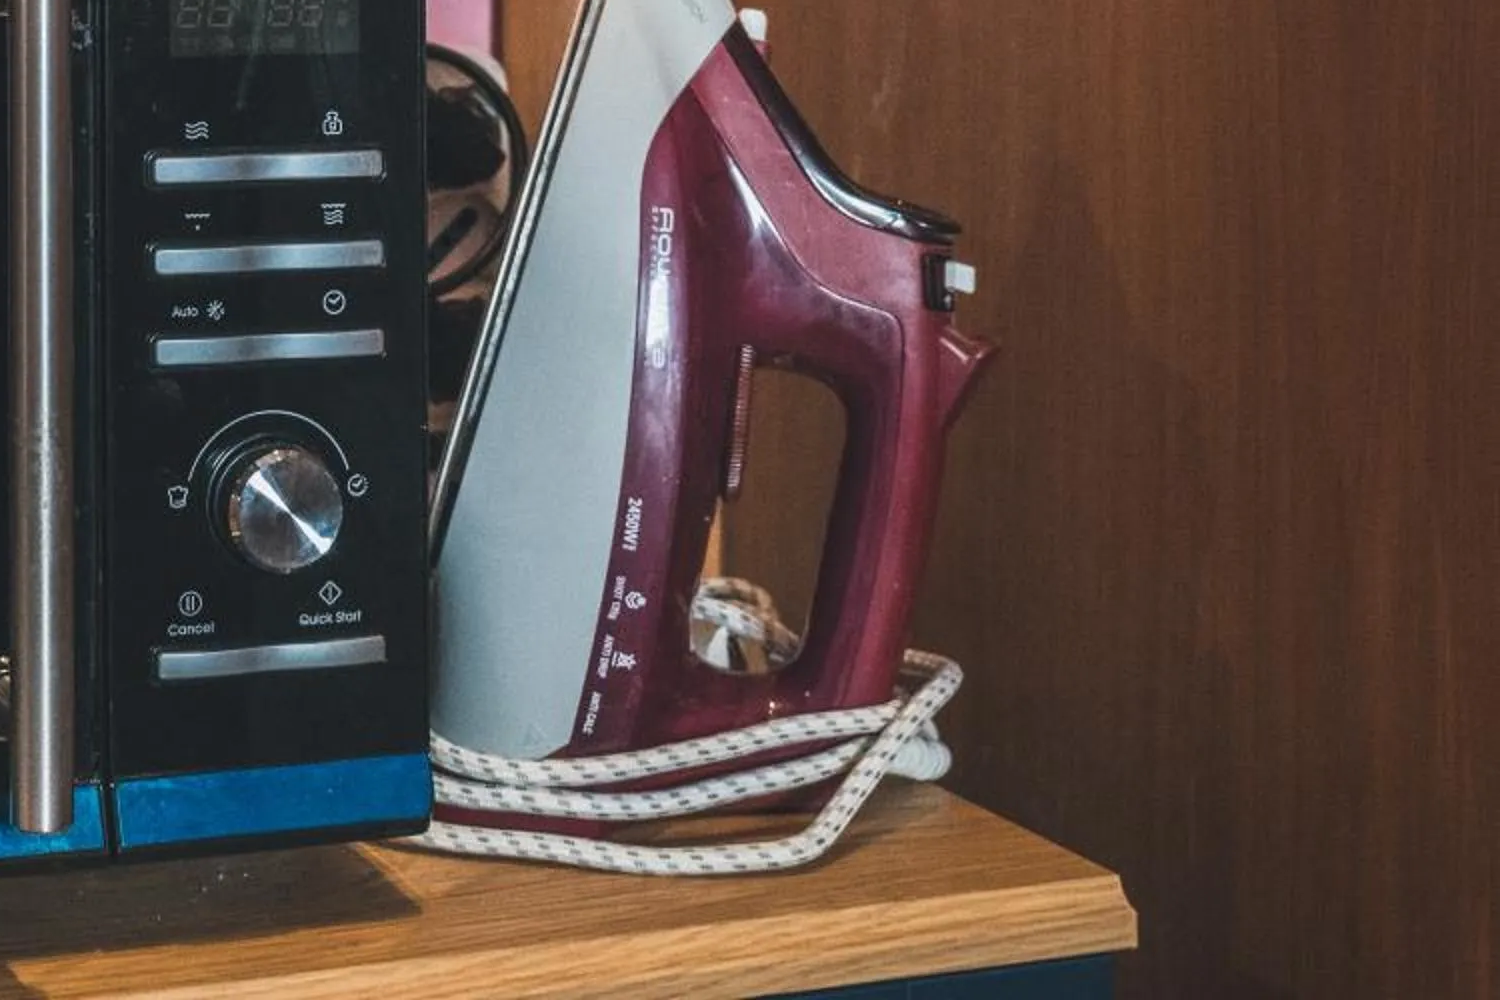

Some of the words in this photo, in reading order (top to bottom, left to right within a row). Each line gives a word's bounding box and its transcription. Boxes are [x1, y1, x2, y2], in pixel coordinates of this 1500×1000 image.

[299, 612, 333, 626] Quick
[336, 610, 362, 624] Start
[167, 621, 215, 637] Cancel
